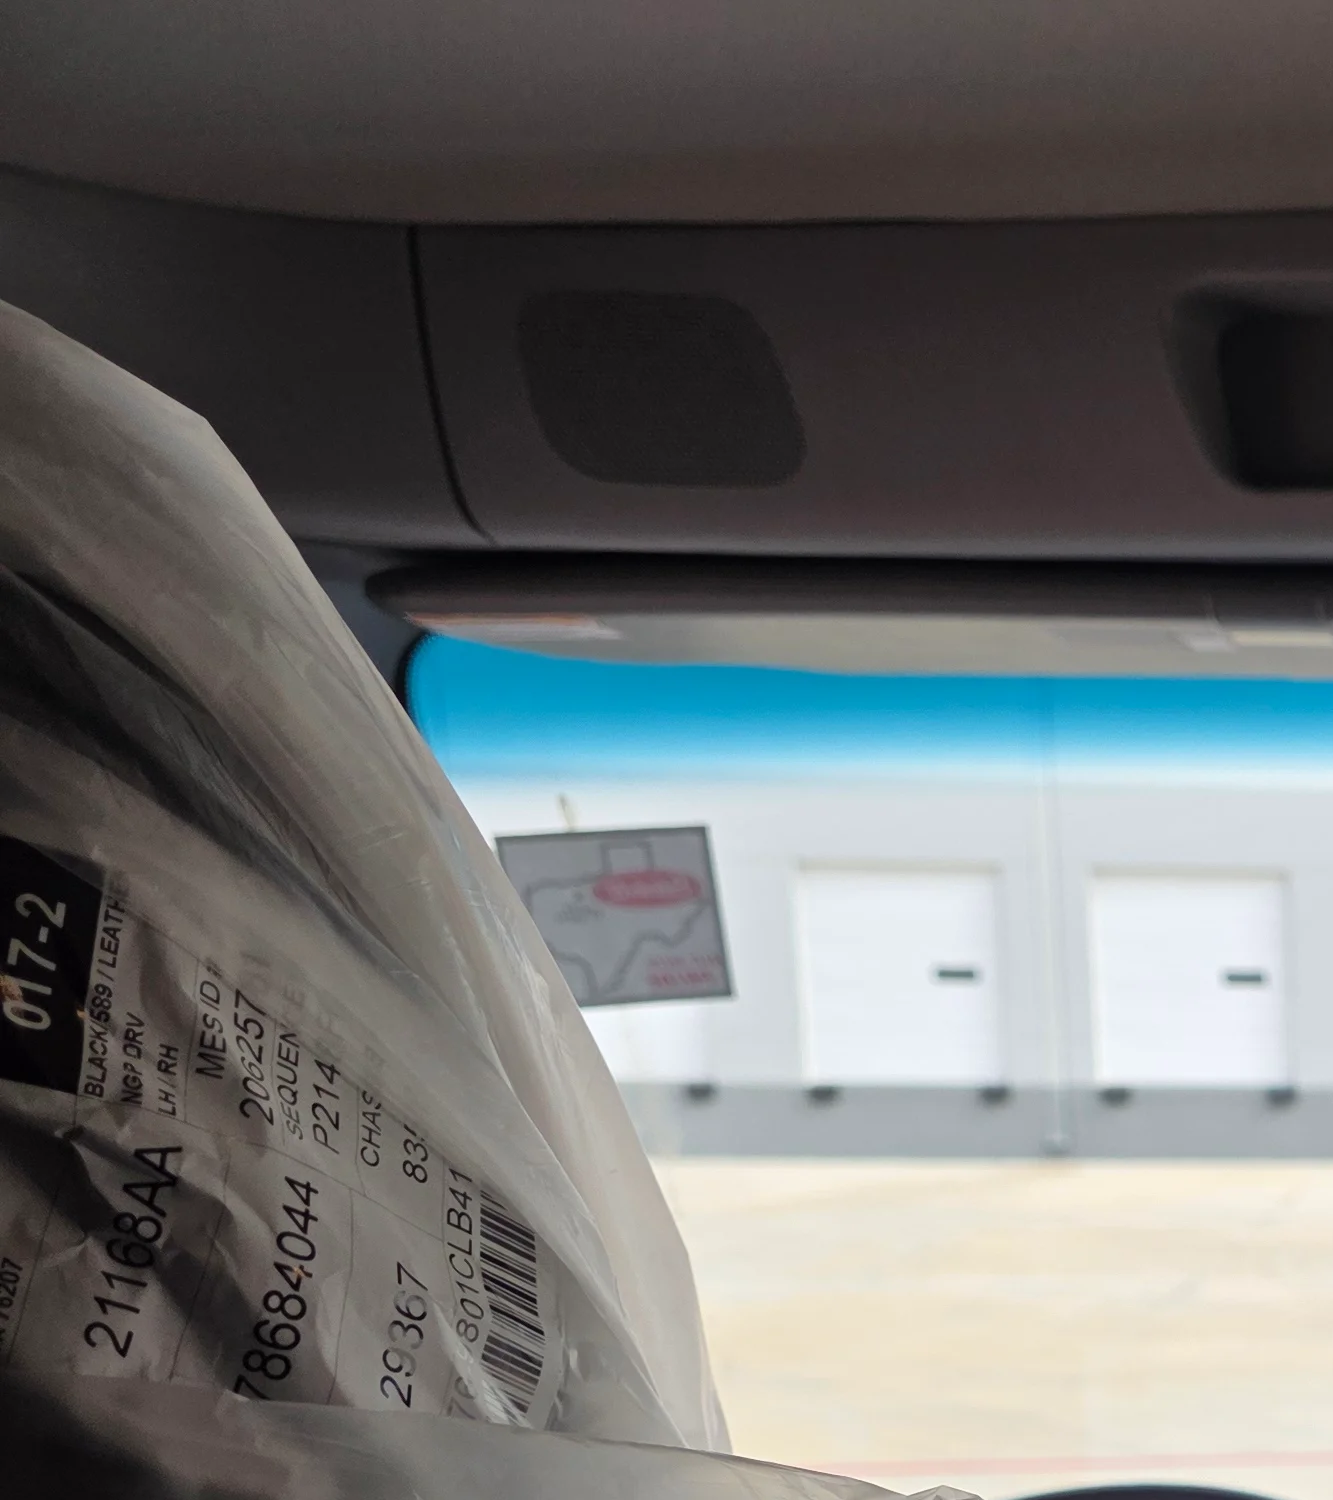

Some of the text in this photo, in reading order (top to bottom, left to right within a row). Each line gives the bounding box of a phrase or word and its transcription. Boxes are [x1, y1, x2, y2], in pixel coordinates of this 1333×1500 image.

[200, 980, 221, 1011] ID
[157, 1043, 179, 1077] RH
[195, 1013, 227, 1080] MES
[84, 1146, 184, 1359] 21168AA
[379, 1262, 429, 1408] 29367
